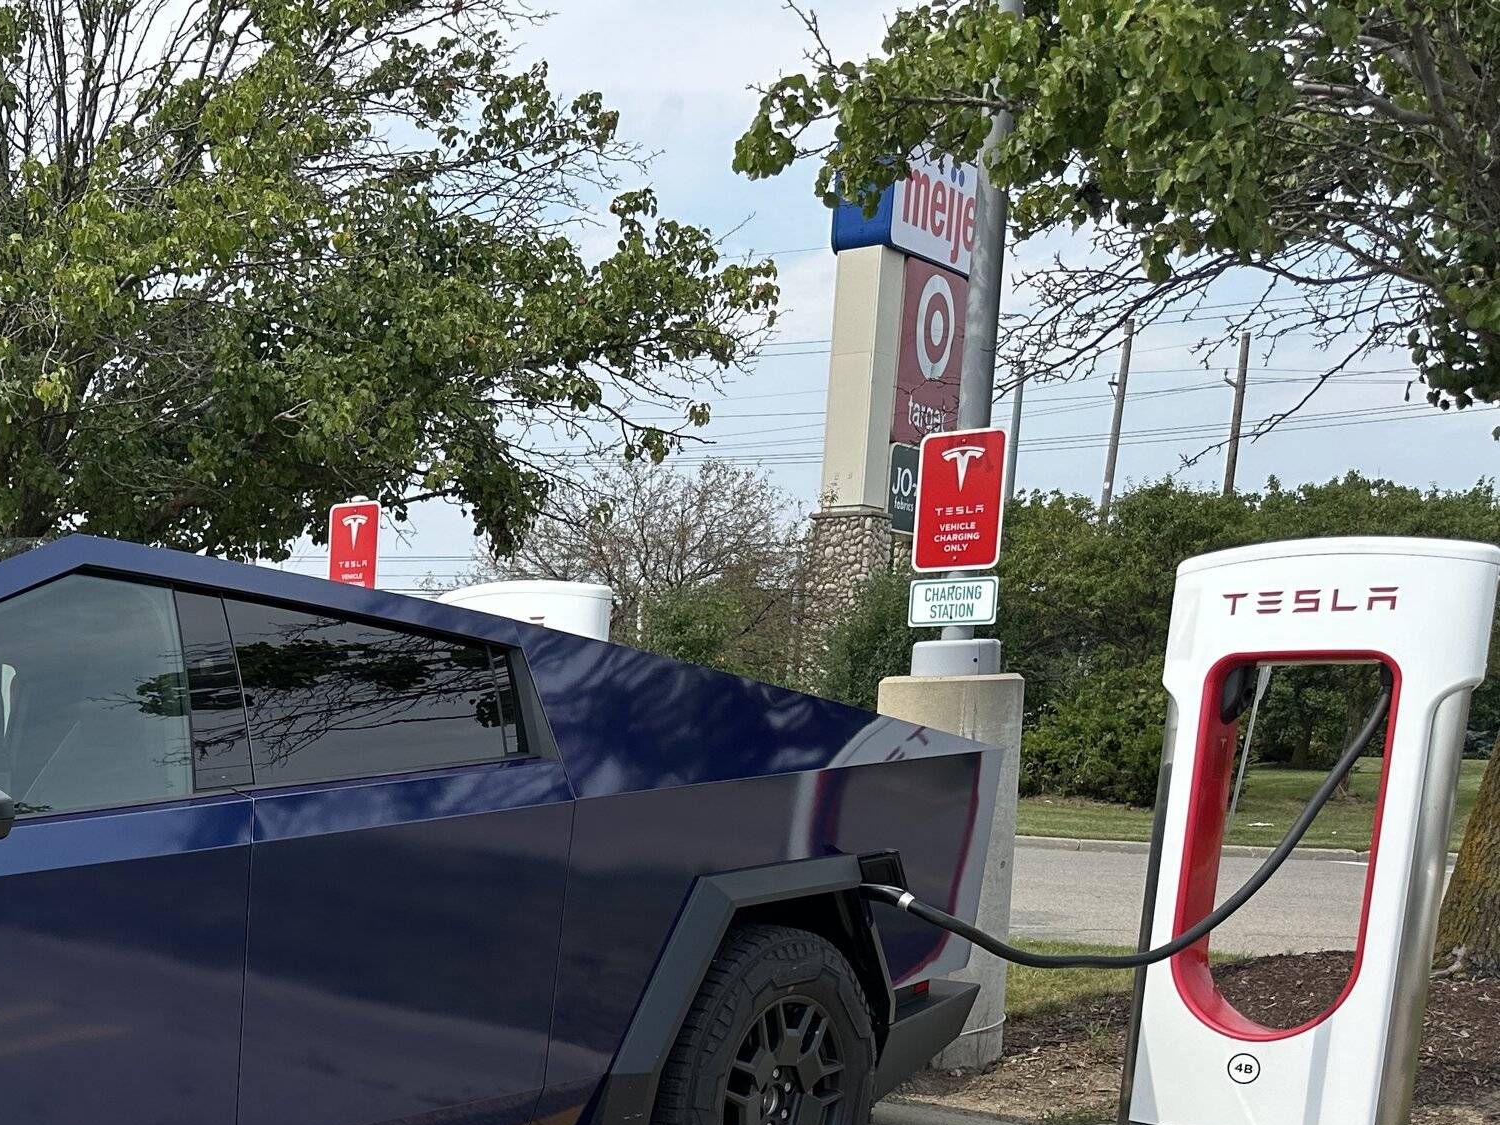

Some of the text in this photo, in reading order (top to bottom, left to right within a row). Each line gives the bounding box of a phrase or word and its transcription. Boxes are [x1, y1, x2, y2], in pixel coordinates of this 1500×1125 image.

[902, 166, 976, 264] meije
[935, 504, 984, 517] TESLA
[940, 521, 976, 532] VEHICLE
[934, 532, 980, 543] CHARGING
[944, 543, 969, 553] ONLY
[338, 560, 368, 568] TESLA
[925, 585, 982, 602] CHARGING
[1222, 586, 1399, 616] TESLA
[930, 603, 974, 619] STATION
[1234, 1063, 1253, 1074] 4B
